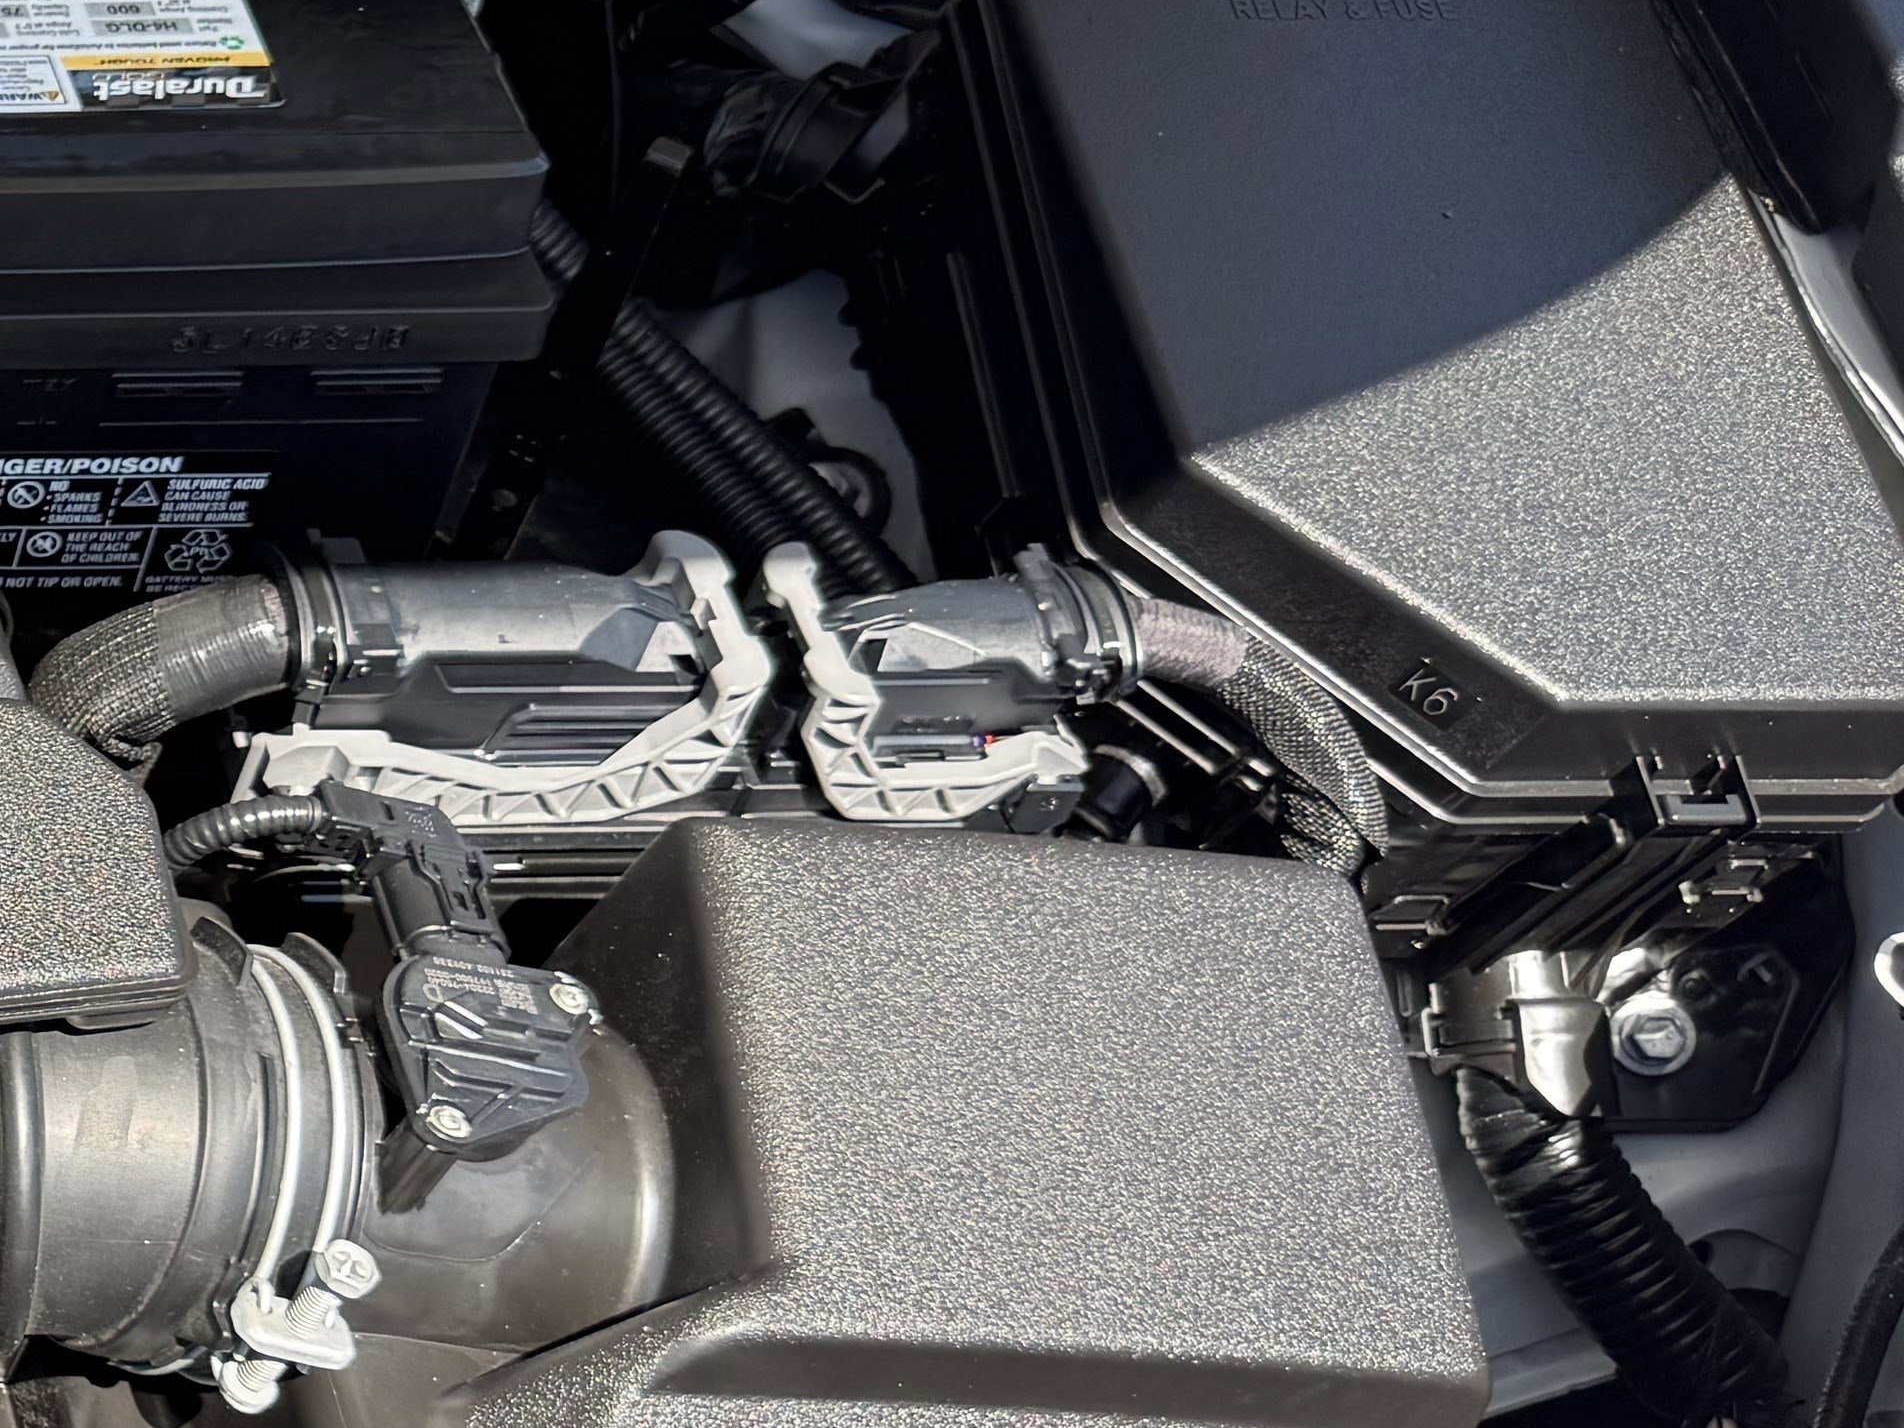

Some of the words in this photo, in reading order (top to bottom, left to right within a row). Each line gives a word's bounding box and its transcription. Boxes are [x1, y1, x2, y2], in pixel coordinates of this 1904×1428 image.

[1, 6, 20, 17] 75
[107, 4, 140, 15] 600
[1344, 0, 1366, 20] &
[106, 22, 178, 33] H4-DLG
[162, 56, 231, 65] PROVEN
[93, 75, 267, 102] Duralast
[49, 480, 71, 492] NO
[167, 479, 233, 490] SULFURIC
[233, 478, 269, 490] ACID
[53, 492, 102, 502] SPARKS
[164, 491, 191, 501] CAN
[191, 491, 232, 501] CAUSE
[50, 503, 100, 513] FLAMES
[161, 501, 228, 512] BLINDNESS
[229, 501, 249, 511] OR
[47, 514, 104, 524] SMOKING
[158, 512, 203, 522] SEVERE
[204, 512, 249, 522] BURNS.
[67, 531, 99, 542] KEEP
[99, 531, 125, 541] OUT
[125, 531, 143, 541] OF
[65, 542, 88, 552] THE
[88, 542, 131, 552] REACH
[61, 553, 78, 563] OF
[78, 552, 141, 563] CHILDREN.
[5, 576, 35, 588] NOT
[37, 576, 60, 588] TIP
[60, 575, 83, 587] OR
[83, 575, 123, 587] OPEN.
[145, 575, 198, 584] BATTERY
[1398, 665, 1458, 717] K6
